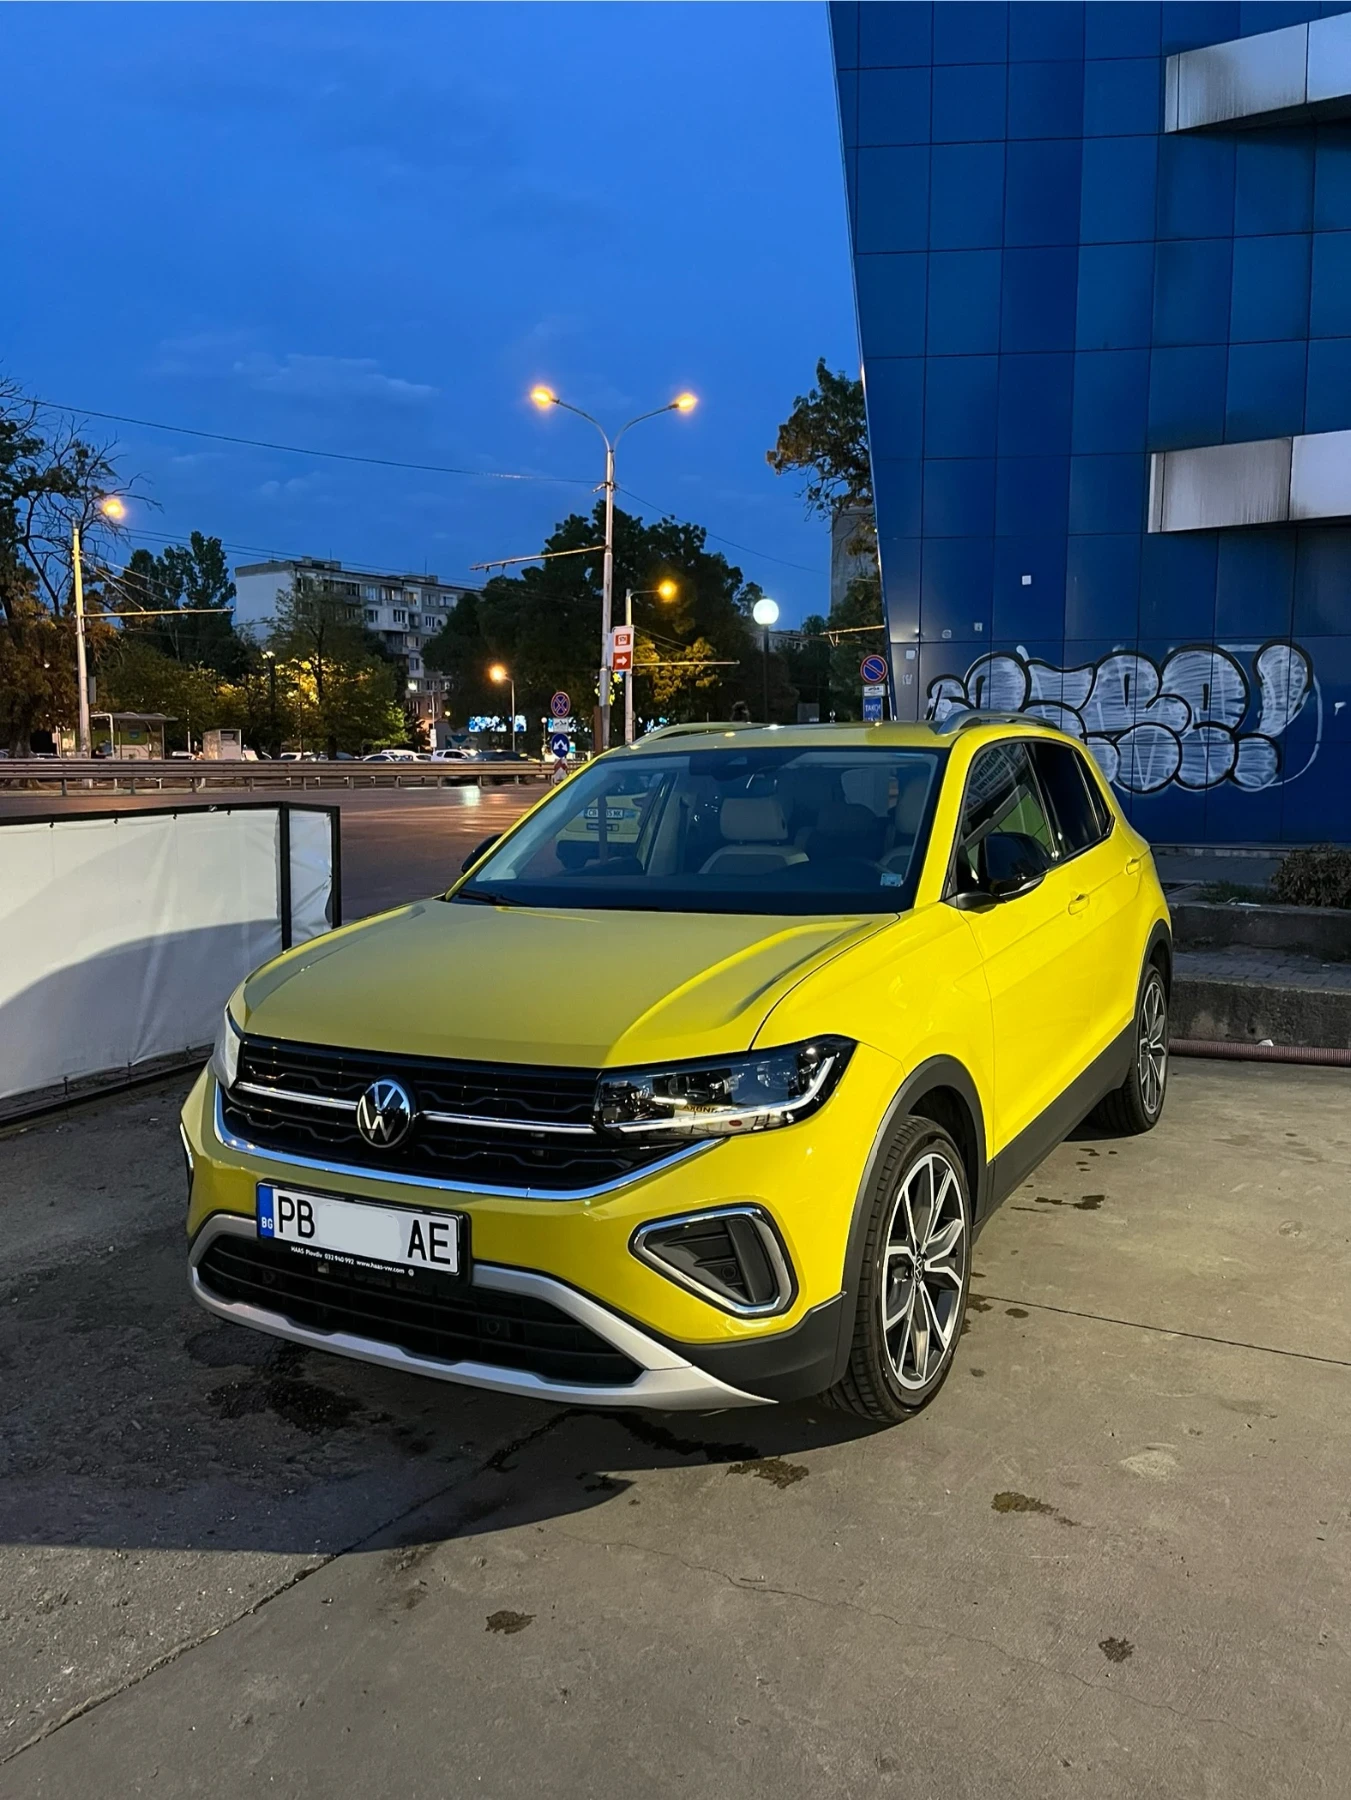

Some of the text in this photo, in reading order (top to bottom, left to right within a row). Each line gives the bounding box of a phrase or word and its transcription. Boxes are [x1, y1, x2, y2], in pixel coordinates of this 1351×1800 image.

[261, 1216, 273, 1229] BG
[278, 1195, 451, 1265] PB AE
[291, 1245, 304, 1254] HAAS
[356, 1260, 405, 1274] www.haas-vw.com
